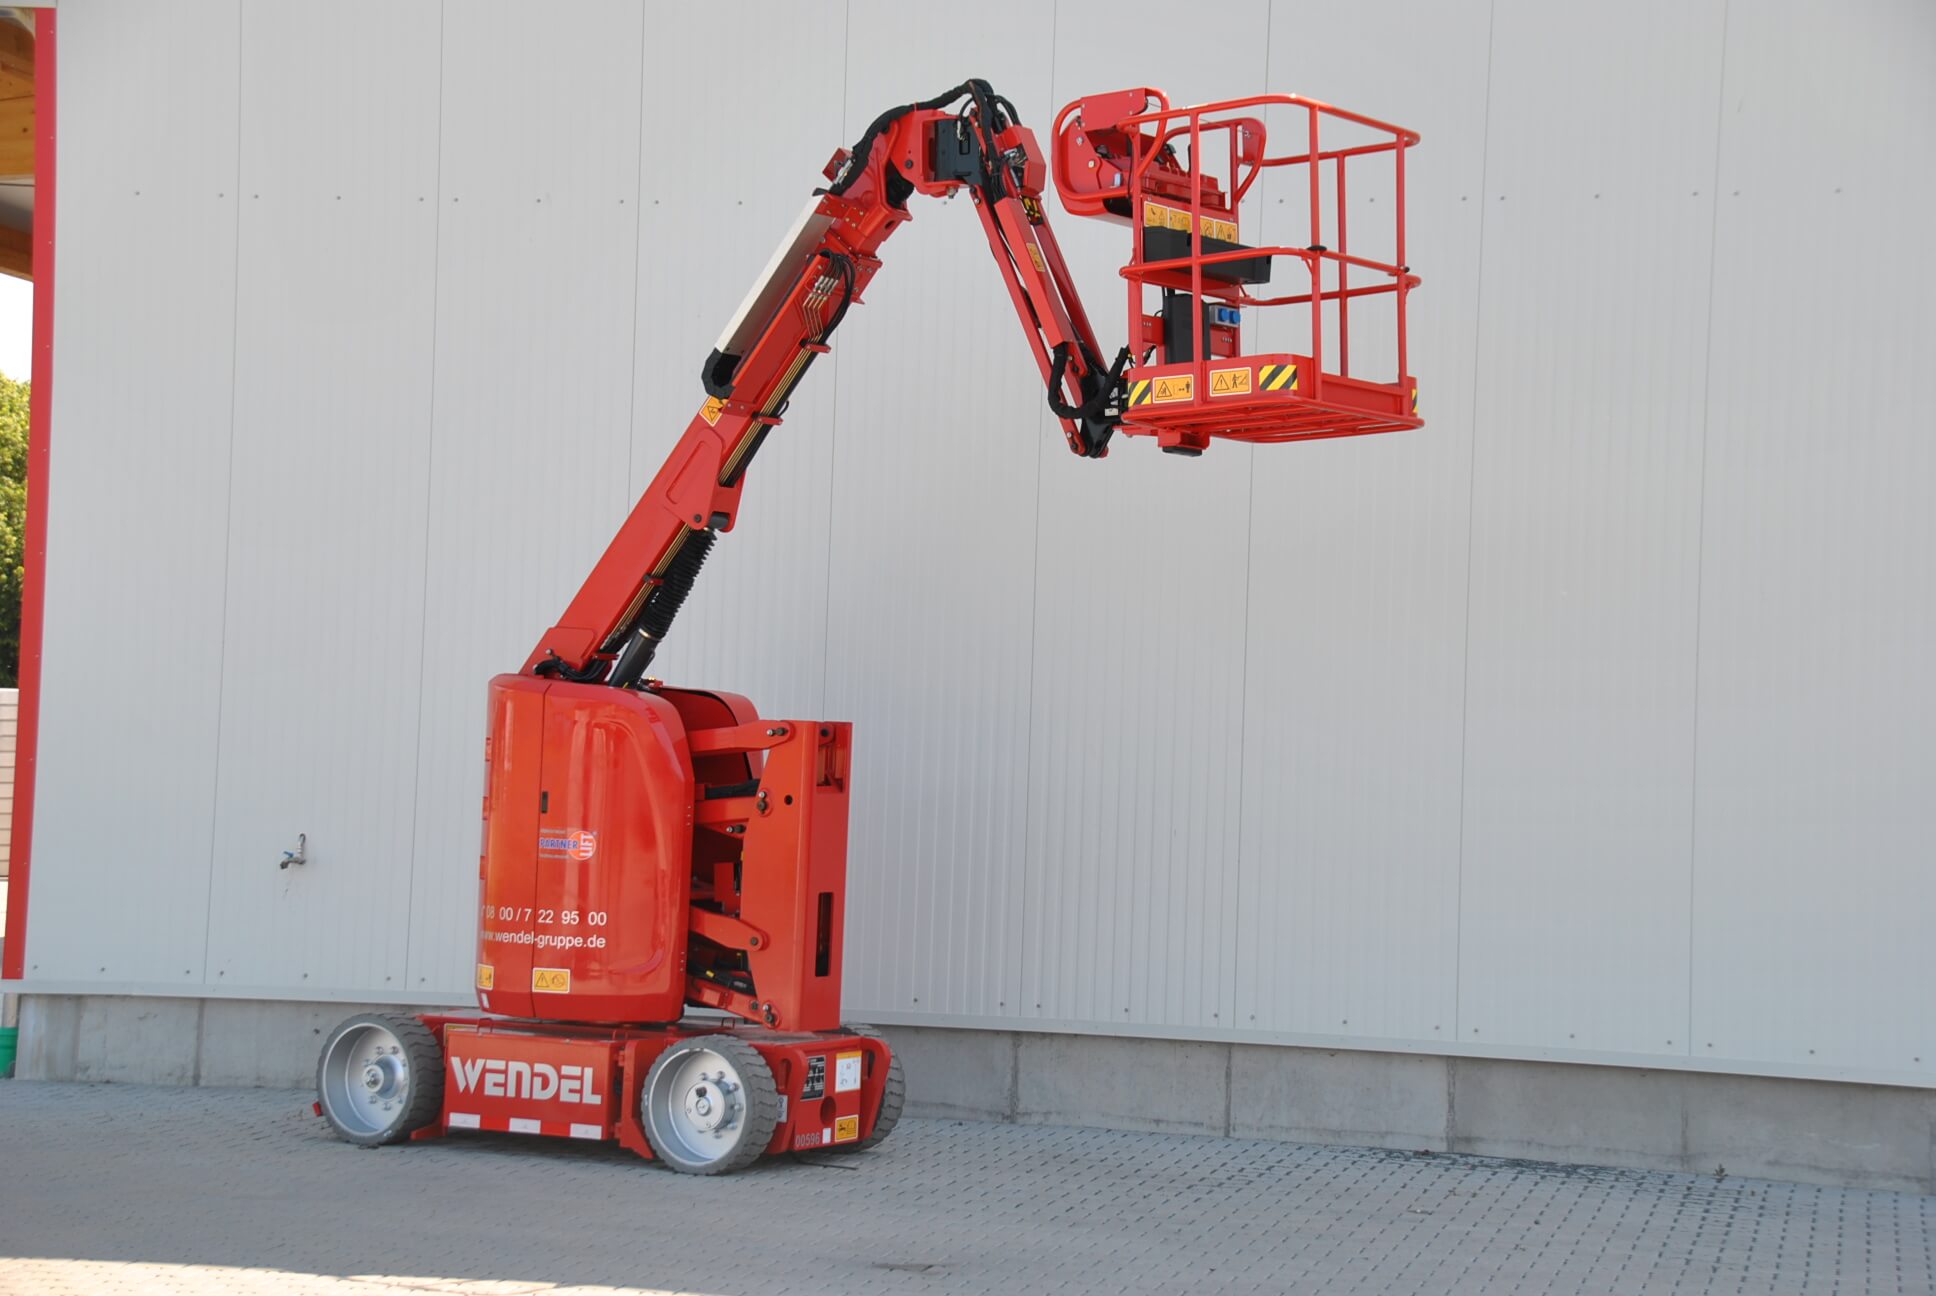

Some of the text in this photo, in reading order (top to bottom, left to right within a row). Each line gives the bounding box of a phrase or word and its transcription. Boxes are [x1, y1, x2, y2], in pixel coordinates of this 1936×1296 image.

[540, 838, 578, 849] PARTNER
[580, 833, 593, 857] LIFT
[538, 909, 554, 924] 22
[561, 910, 579, 925] 95
[588, 911, 607, 926] 00
[451, 1056, 602, 1105] WENDEL
